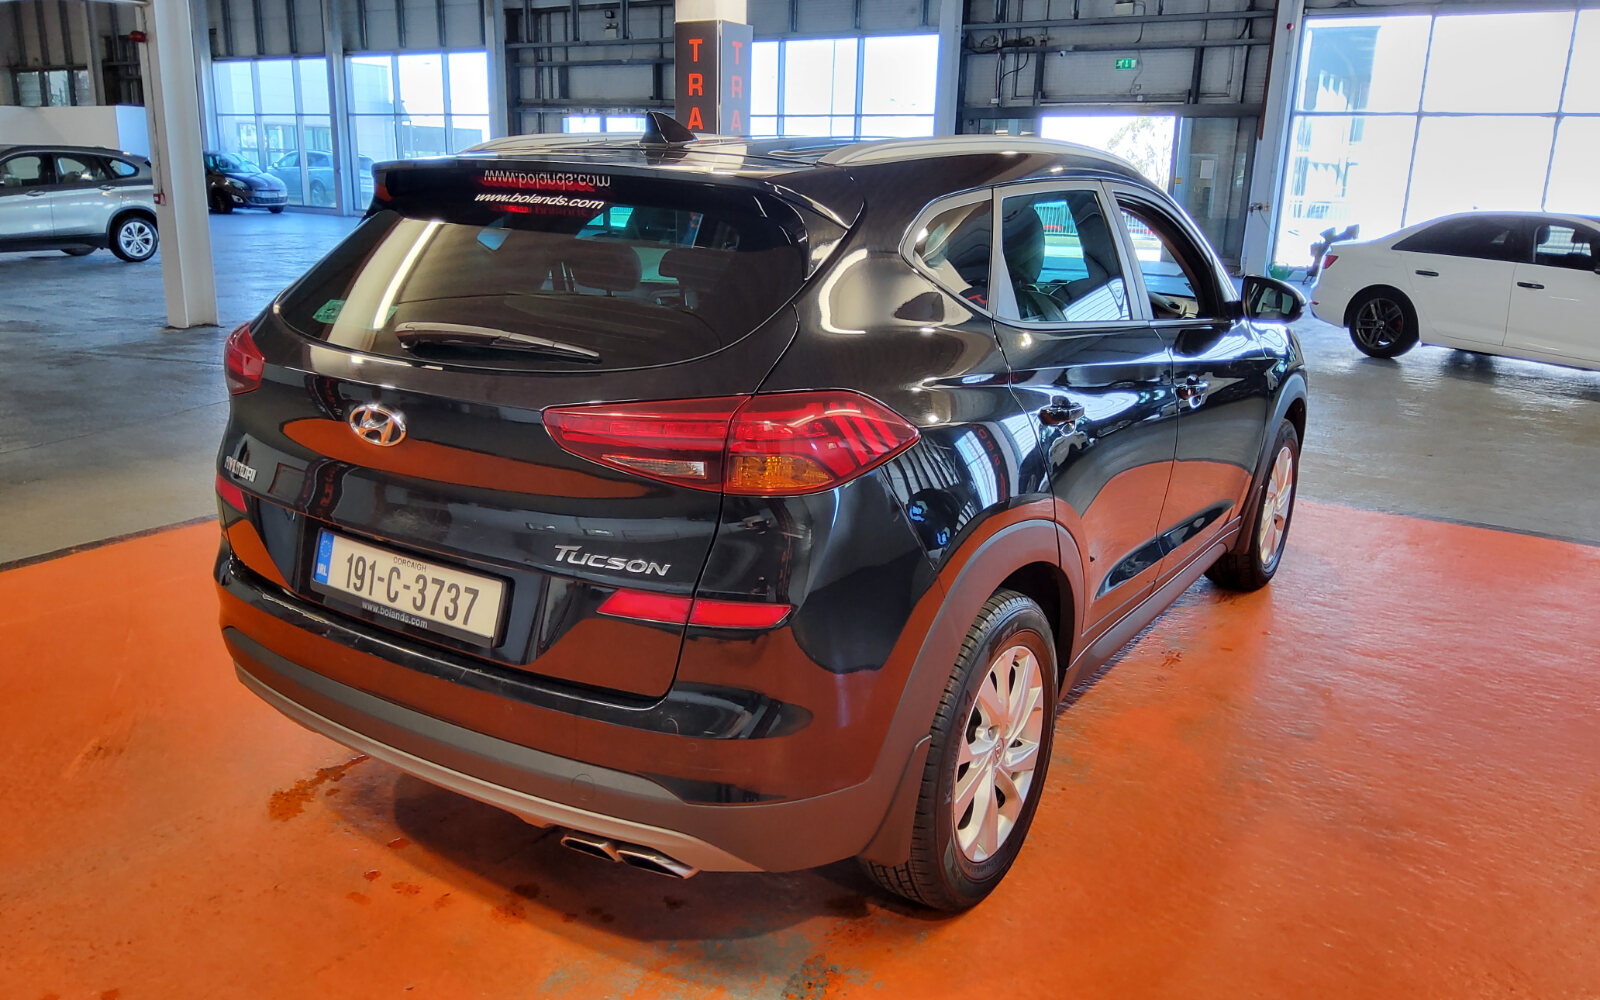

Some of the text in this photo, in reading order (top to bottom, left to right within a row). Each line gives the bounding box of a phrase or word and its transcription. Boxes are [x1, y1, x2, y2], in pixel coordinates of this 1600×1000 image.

[687, 38, 704, 130] TRA
[730, 41, 743, 131] TRA
[474, 193, 605, 209] www.bolands.com
[554, 544, 671, 576] TUCSON
[346, 553, 480, 626] 191-C-3737
[361, 600, 428, 629] www.bolands.com
